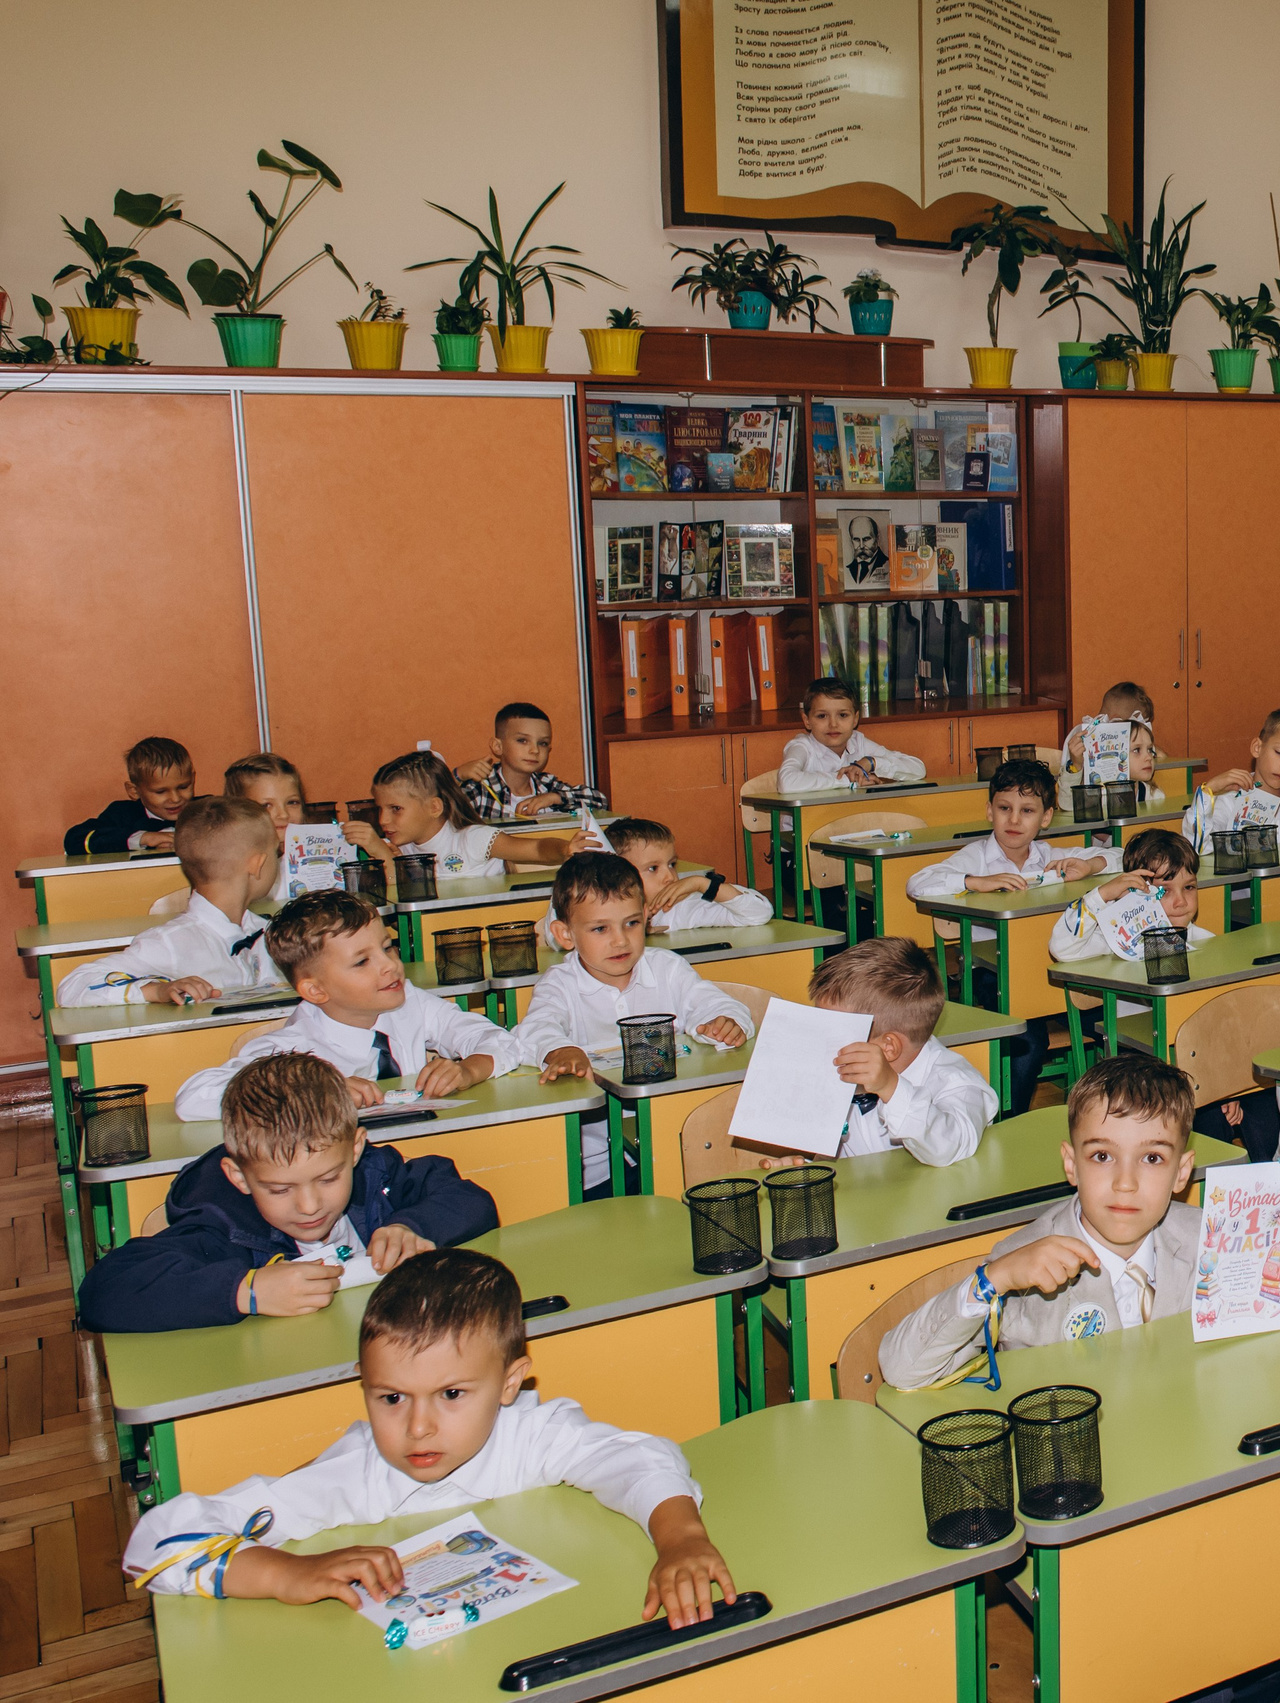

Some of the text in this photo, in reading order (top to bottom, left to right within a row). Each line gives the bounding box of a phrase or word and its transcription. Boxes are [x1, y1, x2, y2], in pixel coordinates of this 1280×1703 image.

[734, 4, 760, 15] Зросту
[810, 2, 835, 11] сином.
[773, 26, 820, 36] починається
[823, 19, 856, 29] людина,
[737, 81, 771, 90] Повинен
[774, 82, 803, 90] кожний
[806, 76, 830, 88] гідний
[737, 96, 840, 114] Сторінки роду свого знати
[757, 94, 803, 103] український
[780, 113, 816, 124] оберігати
[757, 138, 777, 146] рідна
[781, 137, 805, 145] школа
[815, 127, 843, 139] святиня
[739, 170, 762, 178] Добре
[743, 413, 761, 426] 100
[733, 429, 767, 439] Тварини
[1092, 741, 1100, 753] 1
[1241, 806, 1248, 818] 1
[295, 845, 306, 858] 1
[1118, 926, 1131, 942] 1
[1232, 1208, 1260, 1235] у 1
[493, 1569, 527, 1582] 1
[470, 1585, 518, 1606] Віта
[414, 1628, 425, 1637] ICE
[428, 1622, 460, 1634] CHERRY
